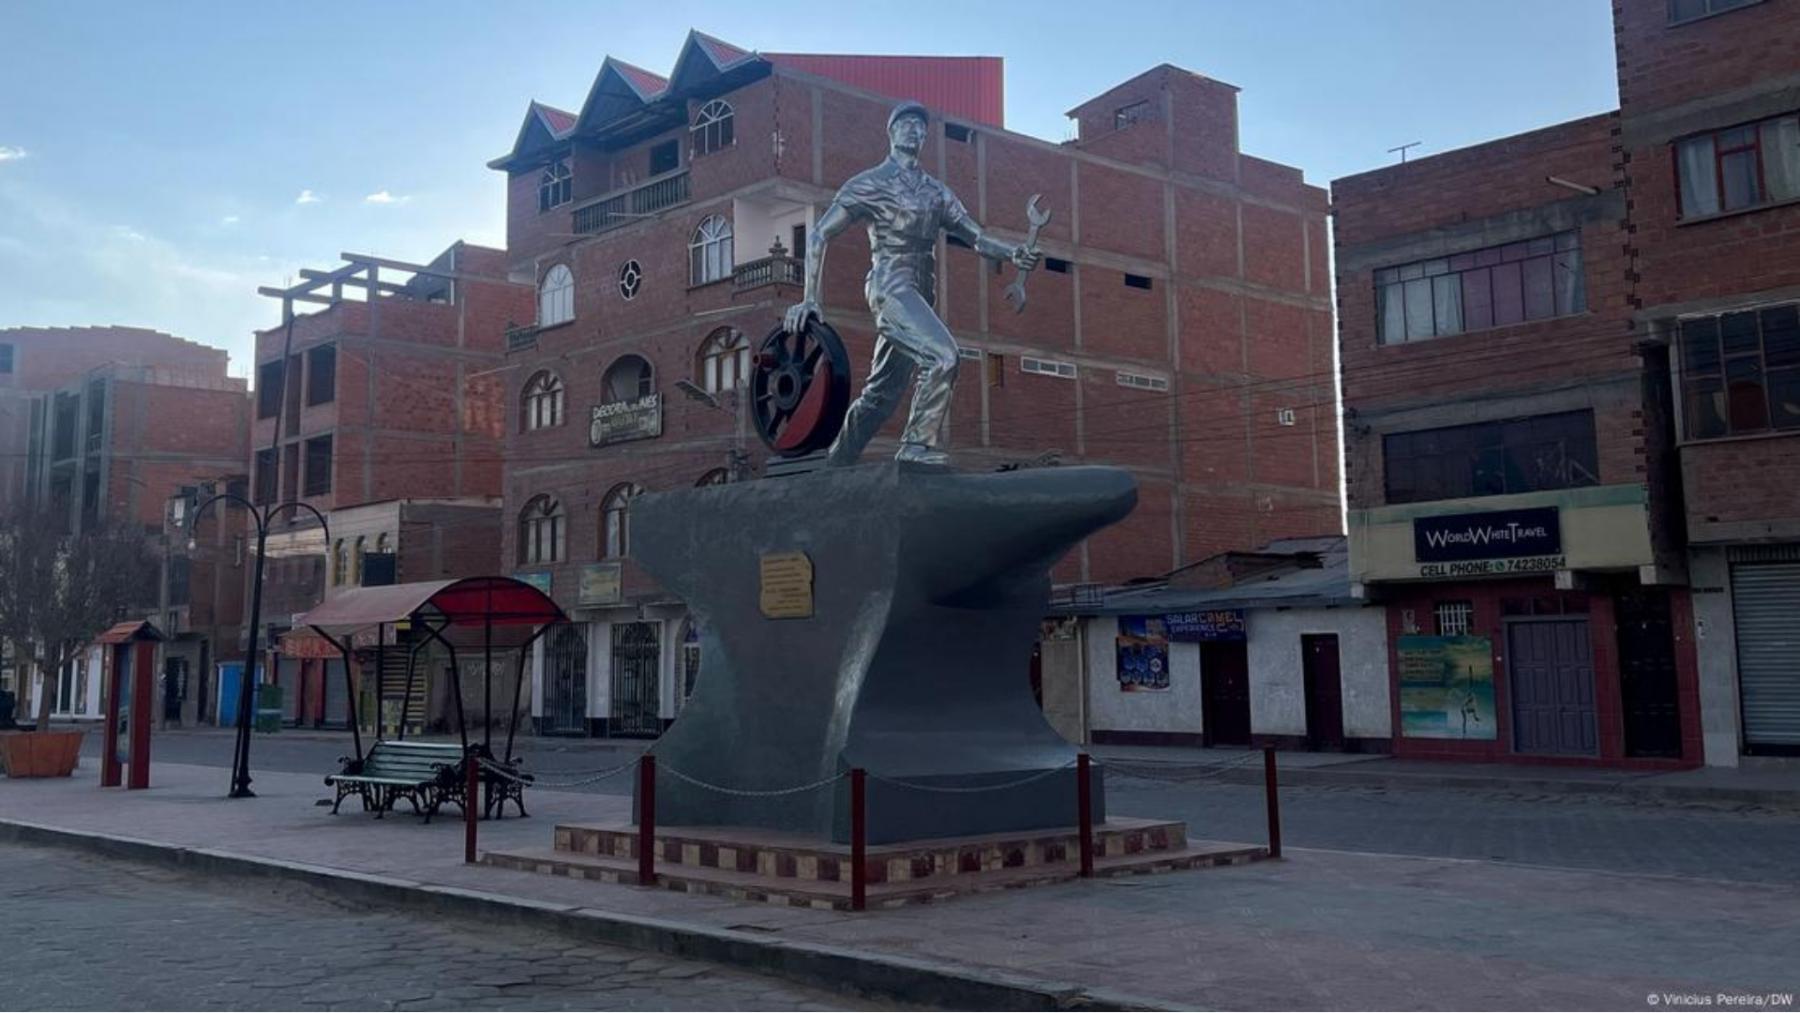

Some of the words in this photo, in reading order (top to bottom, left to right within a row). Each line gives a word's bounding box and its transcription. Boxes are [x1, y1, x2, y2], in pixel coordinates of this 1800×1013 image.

[1420, 563, 1447, 577] CELL
[1450, 561, 1494, 575] PHONE:
[1507, 556, 1566, 571] 74238054
